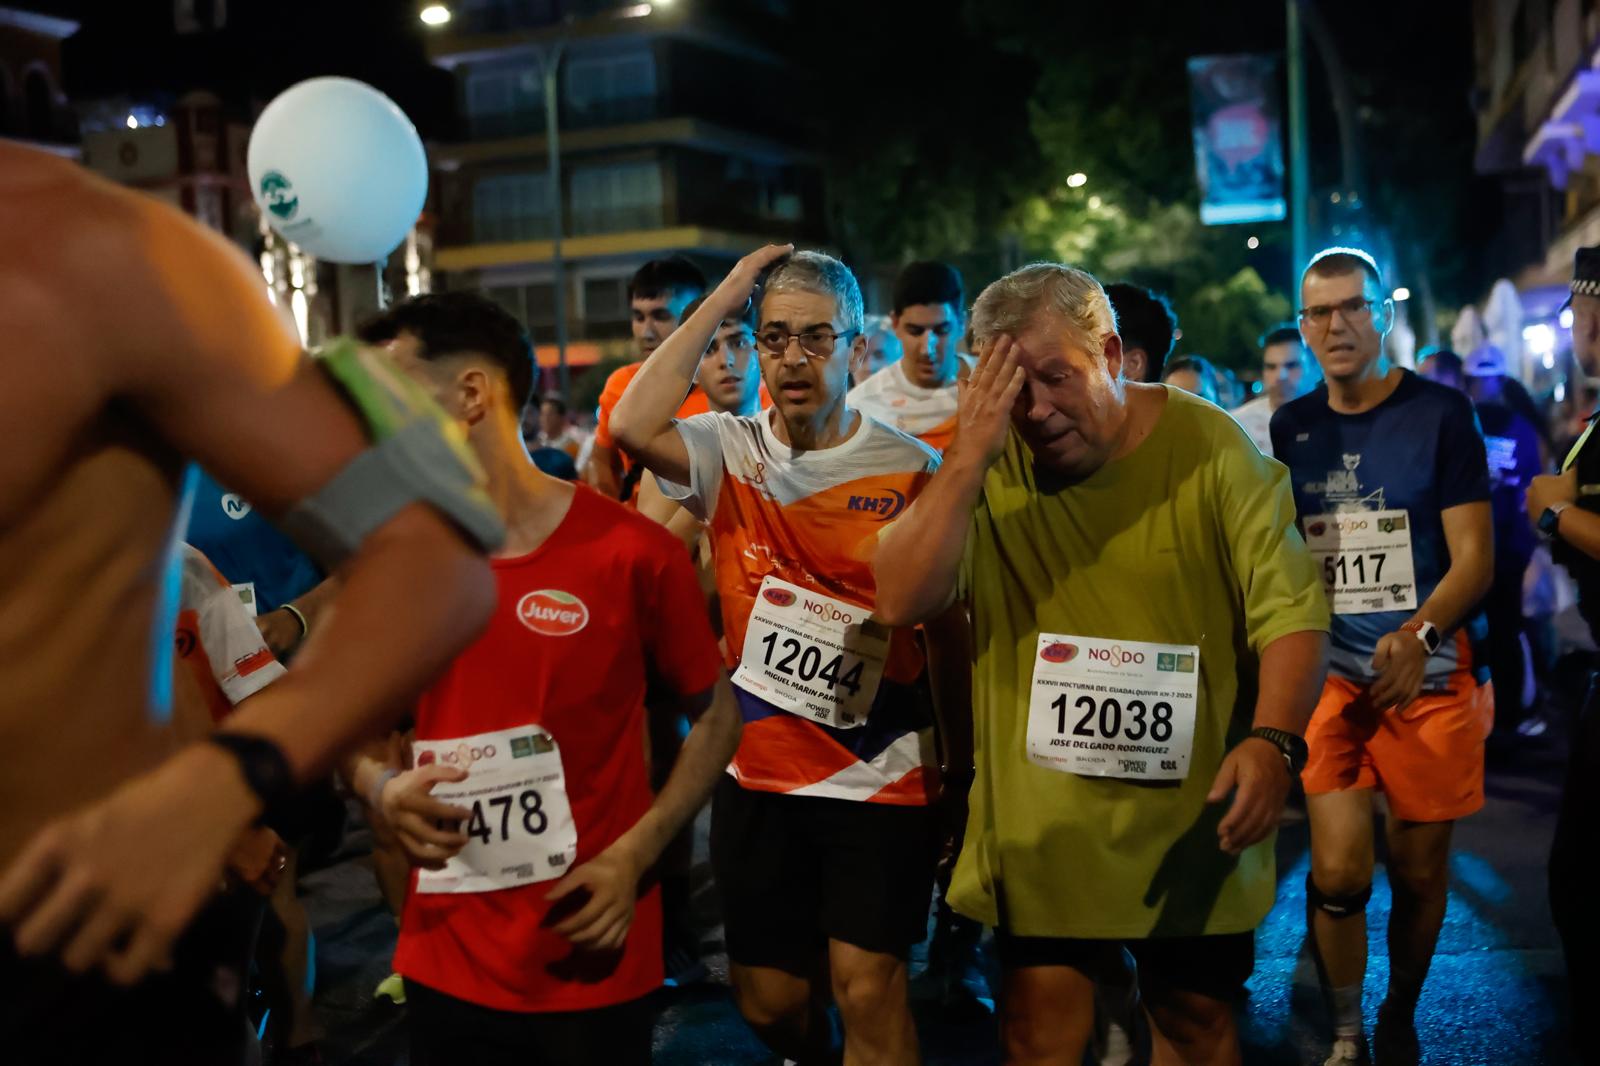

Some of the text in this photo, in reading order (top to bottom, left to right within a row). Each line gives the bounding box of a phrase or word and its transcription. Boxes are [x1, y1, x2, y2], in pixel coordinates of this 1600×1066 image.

[1324, 553, 1386, 585] 5117
[524, 601, 581, 625] Juver
[772, 622, 803, 637] NOCTURNA
[802, 633, 814, 641] DEL
[762, 631, 866, 697] 12044
[764, 669, 845, 705] MIGUEL MARIN PARRA
[1059, 681, 1095, 690] NOCTURNA
[1095, 685, 1108, 693] DEL
[1109, 686, 1159, 697] GUADALQUIVIR
[1051, 693, 1173, 742] 12038
[1049, 738, 1170, 755] JOSE DELGADO RODRIGUEZ
[437, 790, 548, 845] 478
